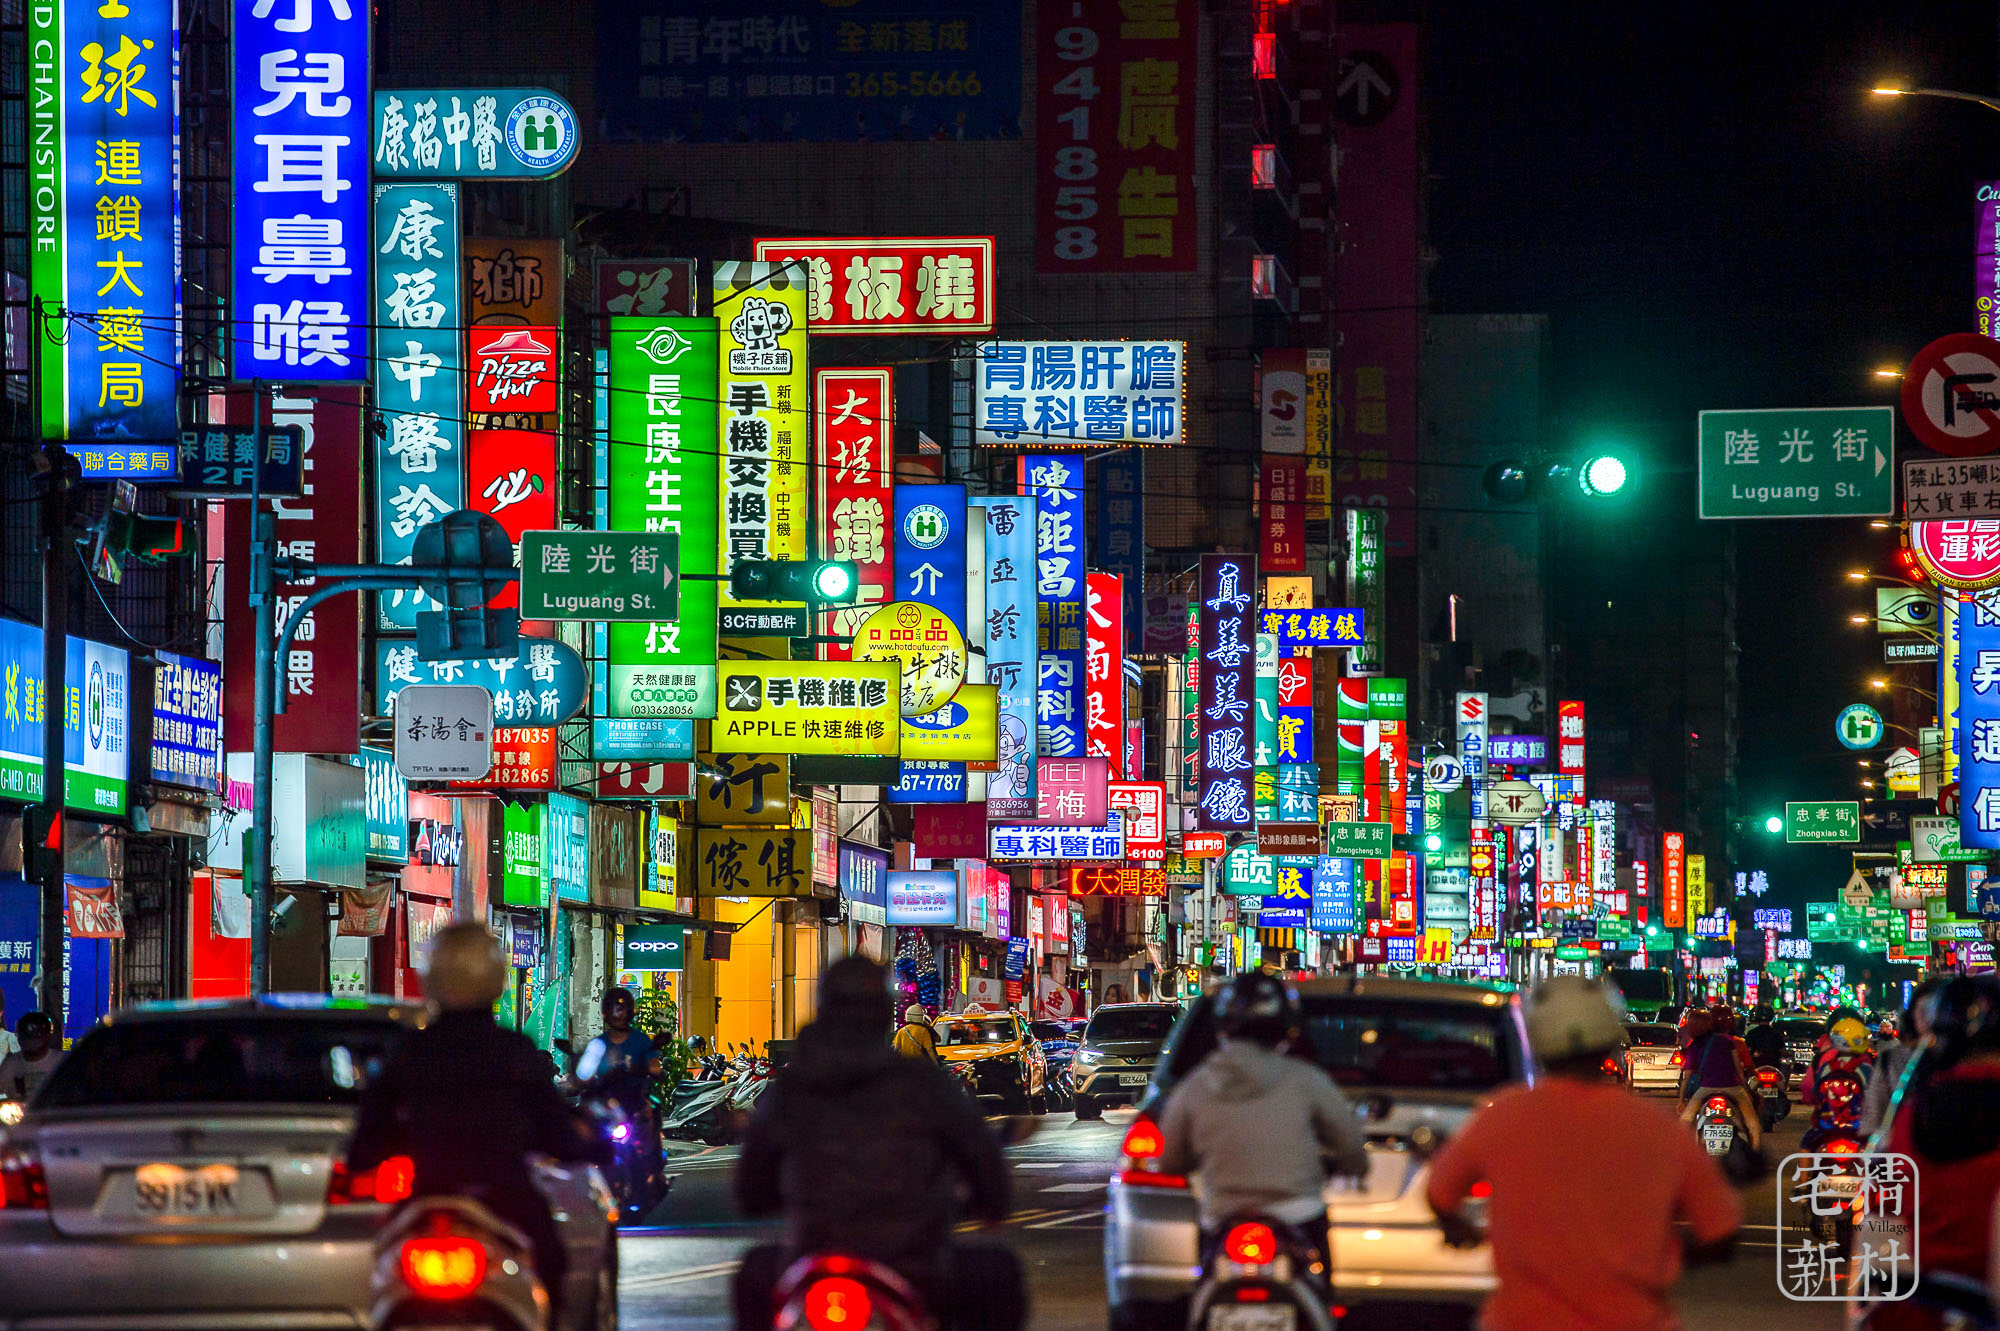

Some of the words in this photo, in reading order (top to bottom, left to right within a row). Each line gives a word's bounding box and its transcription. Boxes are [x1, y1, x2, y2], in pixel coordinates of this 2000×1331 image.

[34, 0, 54, 28] D
[845, 72, 982, 96] 365-5666
[374, 95, 504, 172] 康福中醫
[34, 41, 56, 253] CHAINSTORE
[1977, 184, 2000, 202] Cu
[95, 139, 145, 408] 連鎖大藥局
[476, 355, 548, 389] Pizza
[983, 345, 1177, 391] 胃腸肝膽
[489, 376, 544, 405] Hut
[983, 395, 1177, 440] 專科醫師
[1724, 428, 1868, 465] 陸光街
[1732, 484, 1820, 502] Luguang
[1835, 482, 1862, 498] St.
[644, 374, 683, 655] 長庚生技
[541, 543, 660, 575] 陸光街
[909, 562, 944, 597] 介
[1929, 568, 1955, 585] TAIWAN
[1957, 579, 1983, 588] SPORTS
[542, 594, 625, 613] Luguang
[630, 593, 657, 610] St.
[986, 503, 1023, 691] 雷亞診所
[723, 614, 797, 628] 3C行動配件
[1263, 612, 1362, 641] 寶島鐘錶
[868, 643, 949, 652] www.hotdoufu.com
[633, 673, 697, 686] 天然健康館
[632, 690, 697, 701] 桃園八德門市
[767, 679, 888, 707] 手機維修
[1201, 562, 1252, 824] 真善美眼鏡
[631, 705, 694, 715] (03)3628056
[407, 717, 477, 742] 茶湯會
[608, 721, 638, 731] PHONE
[640, 721, 663, 731] CASE
[727, 720, 797, 736] APPLE
[802, 719, 885, 739] 快速維修
[1281, 765, 1315, 864] 小林
[1796, 808, 1850, 822] 忠孝街
[1184, 838, 1223, 851] 直營門市
[1336, 826, 1385, 842] 忠誠街
[1796, 829, 1838, 839] Zhongxiao
[1839, 829, 1850, 838] St.
[994, 836, 1121, 857] 專科醫師
[1336, 846, 1373, 856] Zhongcheng
[1374, 847, 1384, 856] St.
[704, 837, 805, 891] 傢俱
[1317, 880, 1351, 893] 超市
[628, 941, 679, 953] oppo
